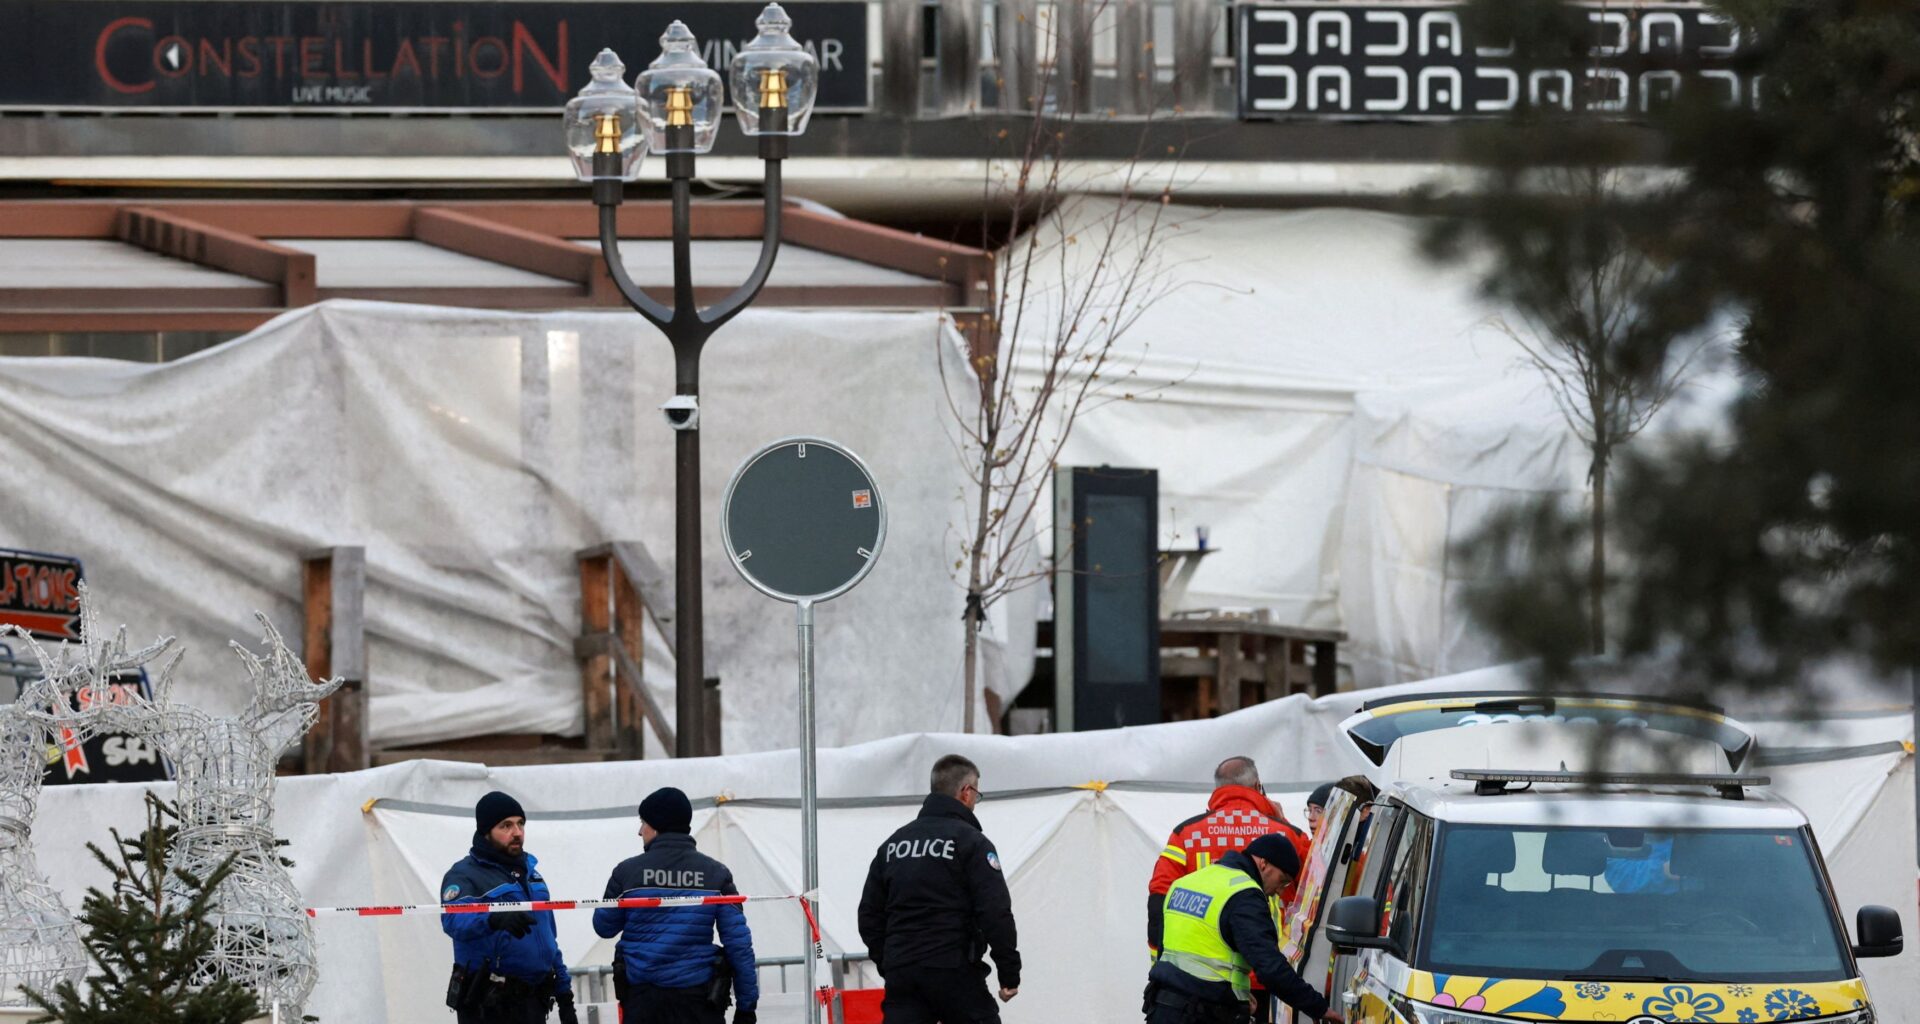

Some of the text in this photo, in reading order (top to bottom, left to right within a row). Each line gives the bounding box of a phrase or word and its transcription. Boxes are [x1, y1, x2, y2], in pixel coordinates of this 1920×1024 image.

[292, 86, 372, 103] LIVE MUSIC
[1208, 826, 1269, 835] COMMANDANT
[886, 838, 955, 862] POLICE
[643, 869, 704, 887] POLICE
[1170, 890, 1209, 915] POLICE
